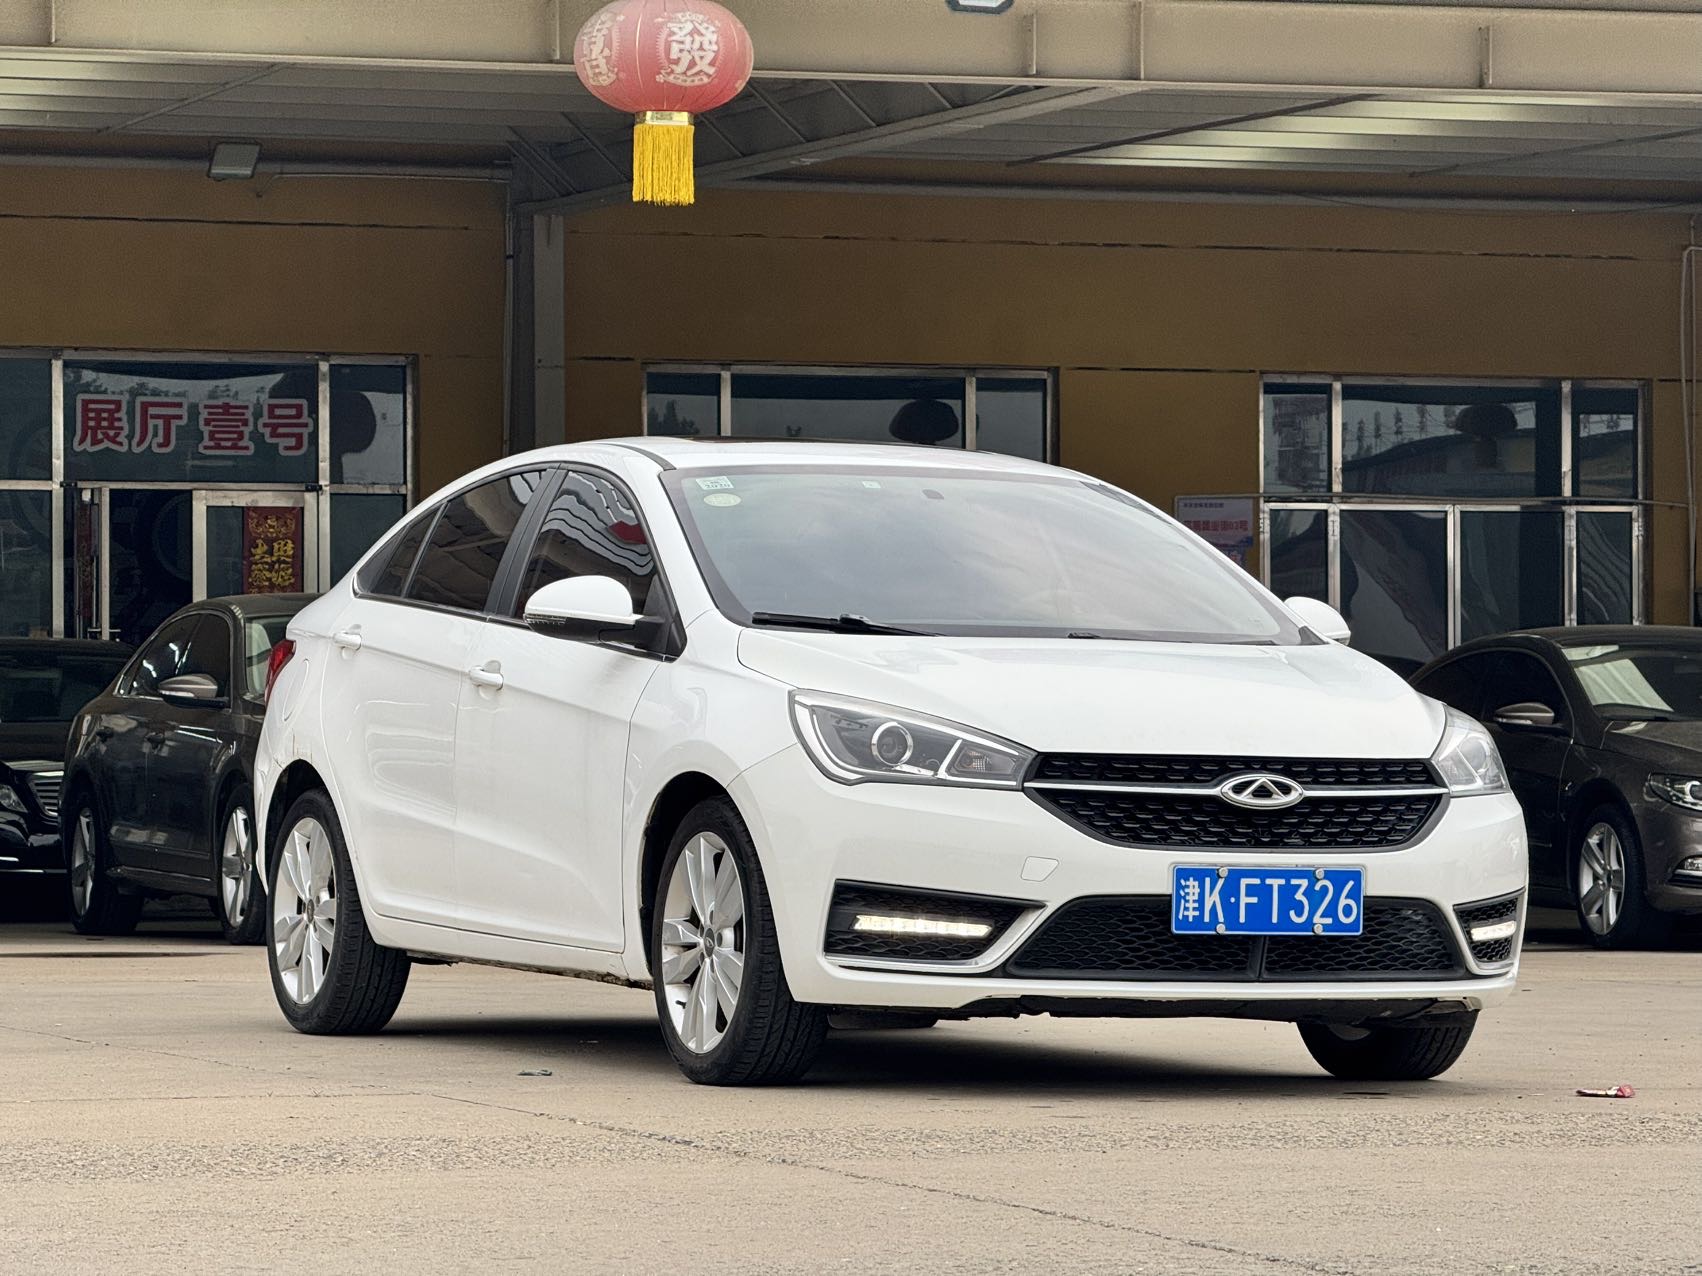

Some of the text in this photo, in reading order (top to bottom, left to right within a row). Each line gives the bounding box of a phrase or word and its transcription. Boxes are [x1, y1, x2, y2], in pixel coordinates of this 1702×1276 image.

[666, 21, 719, 76] 發
[75, 396, 311, 454] 展厅壹号
